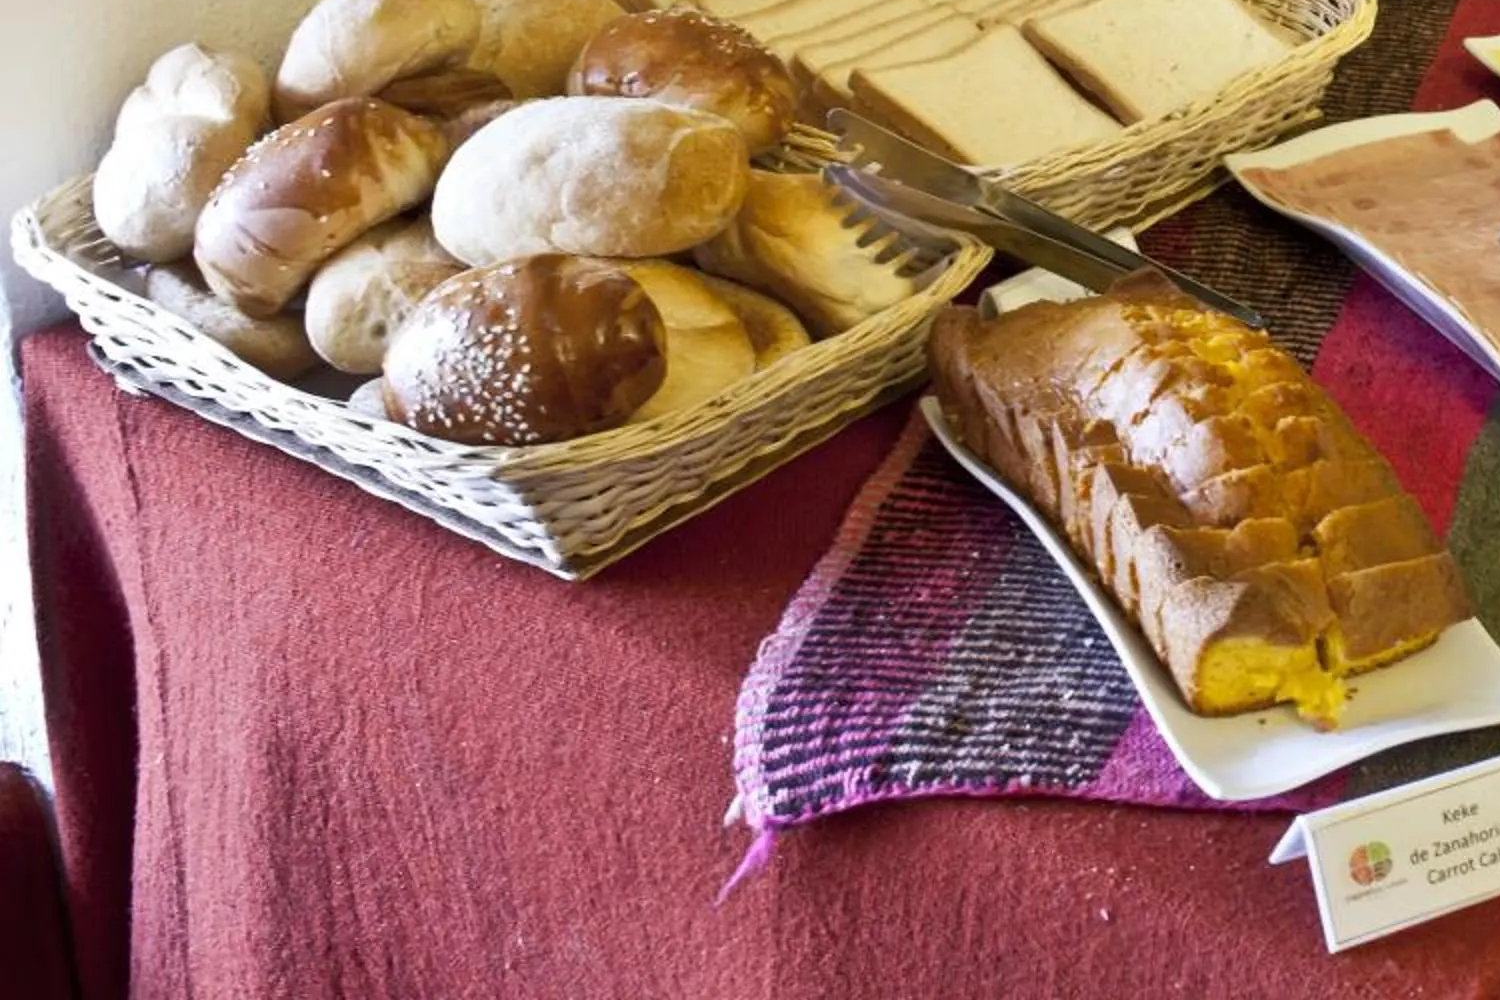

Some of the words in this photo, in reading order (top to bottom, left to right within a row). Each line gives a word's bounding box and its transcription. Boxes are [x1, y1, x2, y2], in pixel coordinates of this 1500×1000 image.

[1442, 802, 1479, 825] Keke
[1410, 849, 1430, 866] de
[1427, 859, 1476, 886] Carrot
